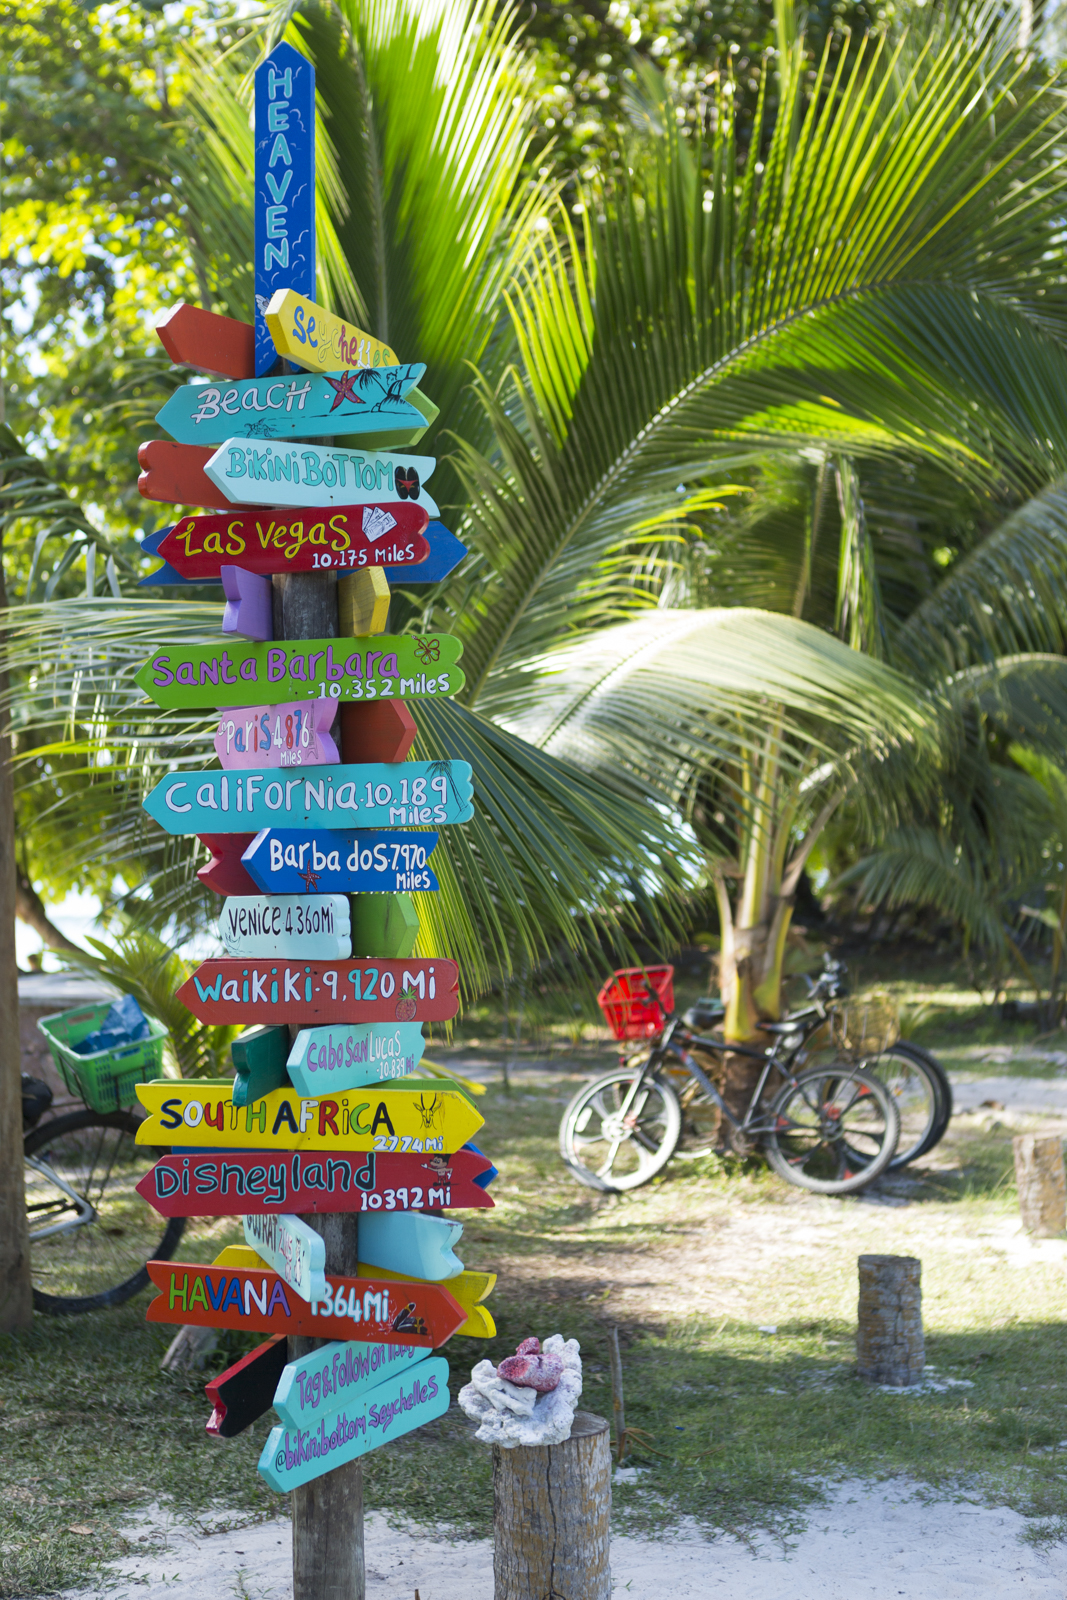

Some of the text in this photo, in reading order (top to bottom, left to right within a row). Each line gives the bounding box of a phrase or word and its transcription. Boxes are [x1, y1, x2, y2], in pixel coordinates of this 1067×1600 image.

[264, 67, 293, 271] HEAVEN
[267, 645, 401, 682] Barbara
[154, 1152, 377, 1204] Disneyland
[360, 1186, 451, 1211] 10392 Mi
[168, 1272, 291, 1317] HAVANA
